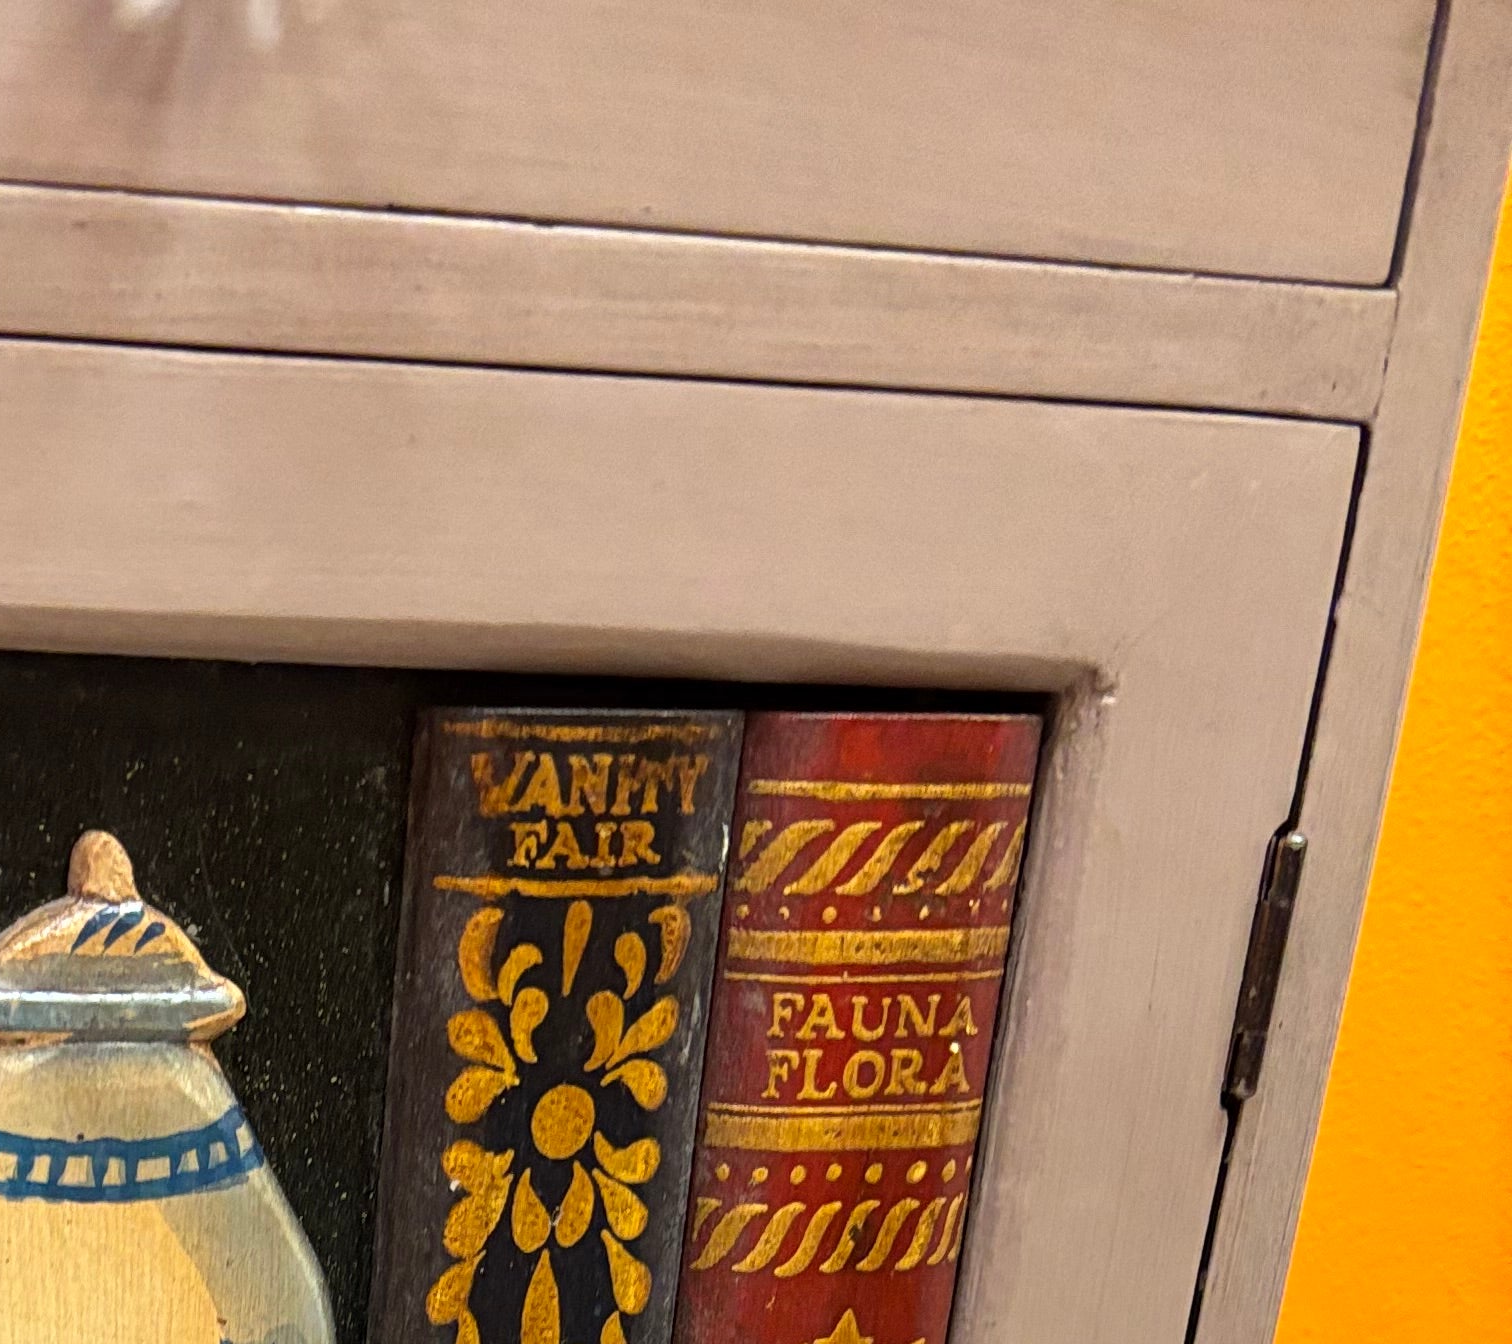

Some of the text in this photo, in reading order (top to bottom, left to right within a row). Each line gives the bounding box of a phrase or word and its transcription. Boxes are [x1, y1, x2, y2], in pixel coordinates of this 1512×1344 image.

[471, 750, 709, 818] VANITY
[507, 819, 660, 869] FAIR
[766, 991, 978, 1041] FAUNA
[761, 1049, 970, 1100] FLORA
